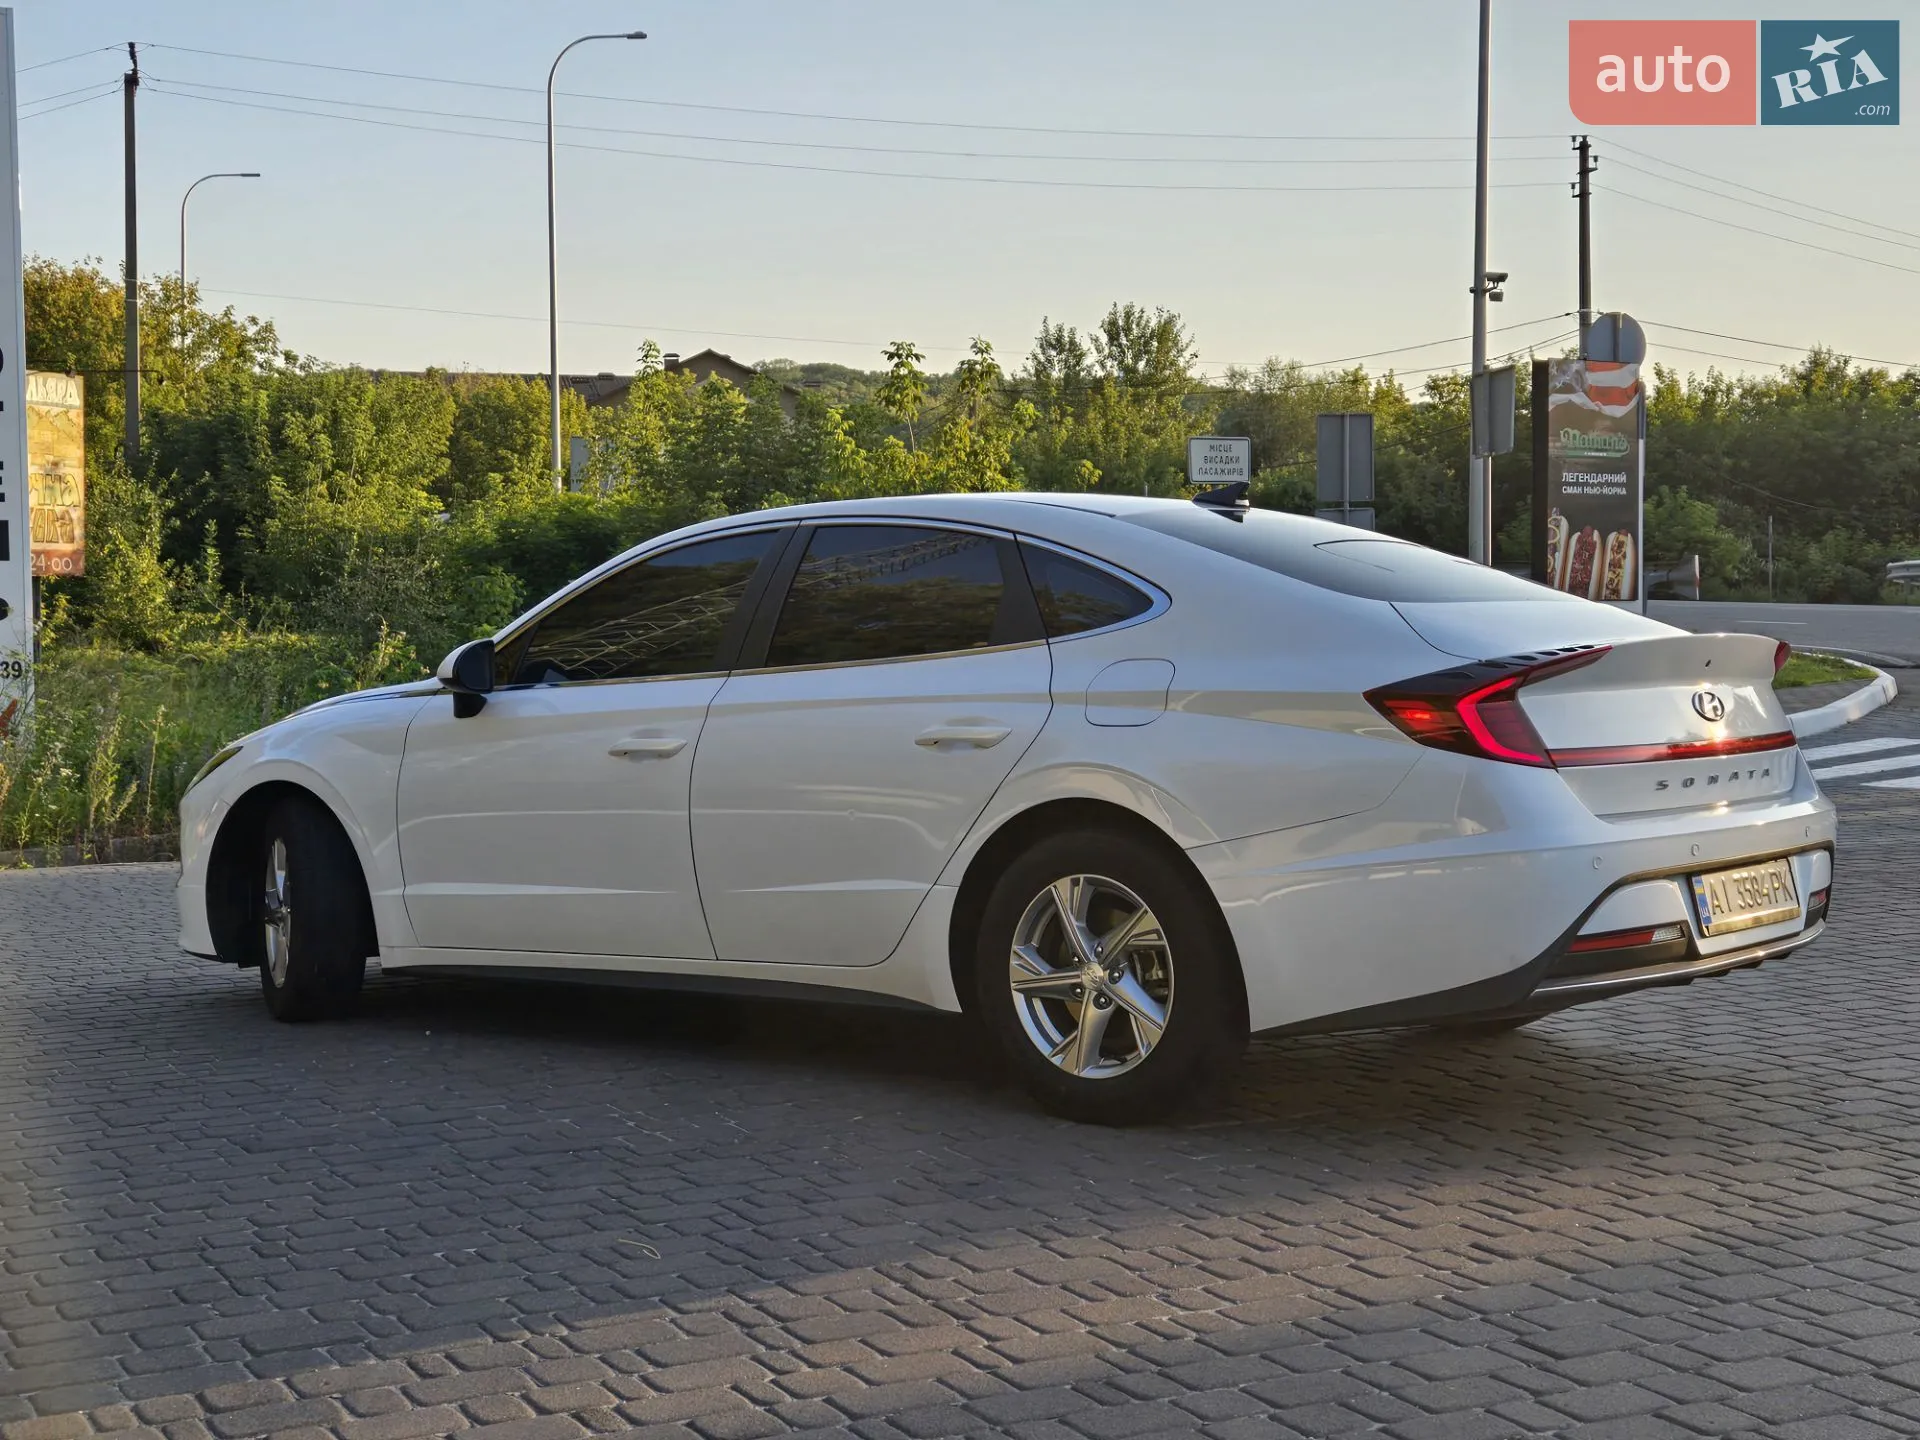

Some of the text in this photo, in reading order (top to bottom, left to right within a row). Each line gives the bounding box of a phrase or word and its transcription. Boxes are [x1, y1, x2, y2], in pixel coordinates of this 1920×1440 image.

[1209, 444, 1233, 453] МІСЦЕ
[1203, 455, 1240, 465] ВИСАДКИ
[1198, 466, 1244, 476] ПАСАЖИРІВ
[1561, 471, 1627, 485] ЛЕГЕНДАРНИЙ
[1562, 485, 1627, 495] СМАК НЬЮ-ЙОРКА
[1655, 768, 1770, 791] SONATA
